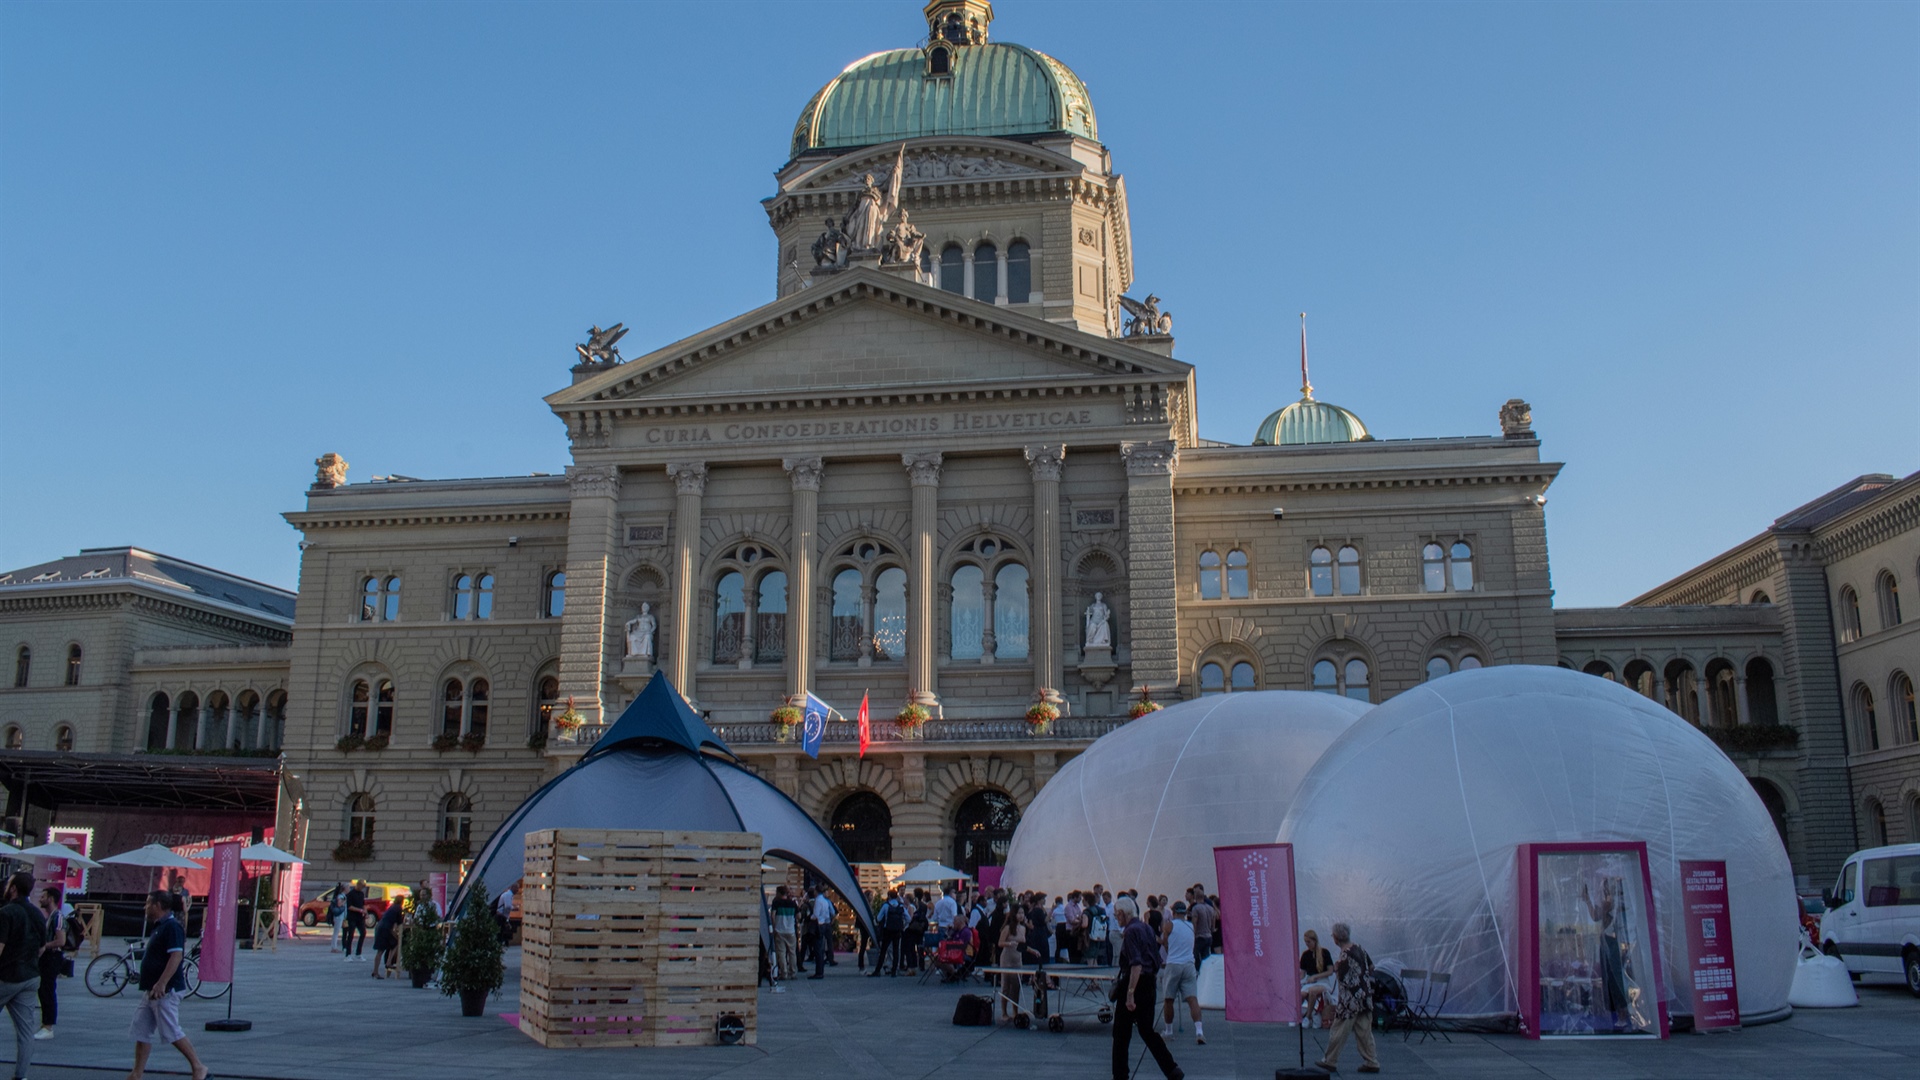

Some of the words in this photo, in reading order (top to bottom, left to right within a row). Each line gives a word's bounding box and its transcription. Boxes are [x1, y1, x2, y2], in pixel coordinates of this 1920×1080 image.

[645, 428, 712, 444] CURIA
[724, 417, 940, 441] CONFOEDERATIONIS
[952, 410, 1093, 431] HELVETICAE
[144, 833, 210, 846] TOGETHER
